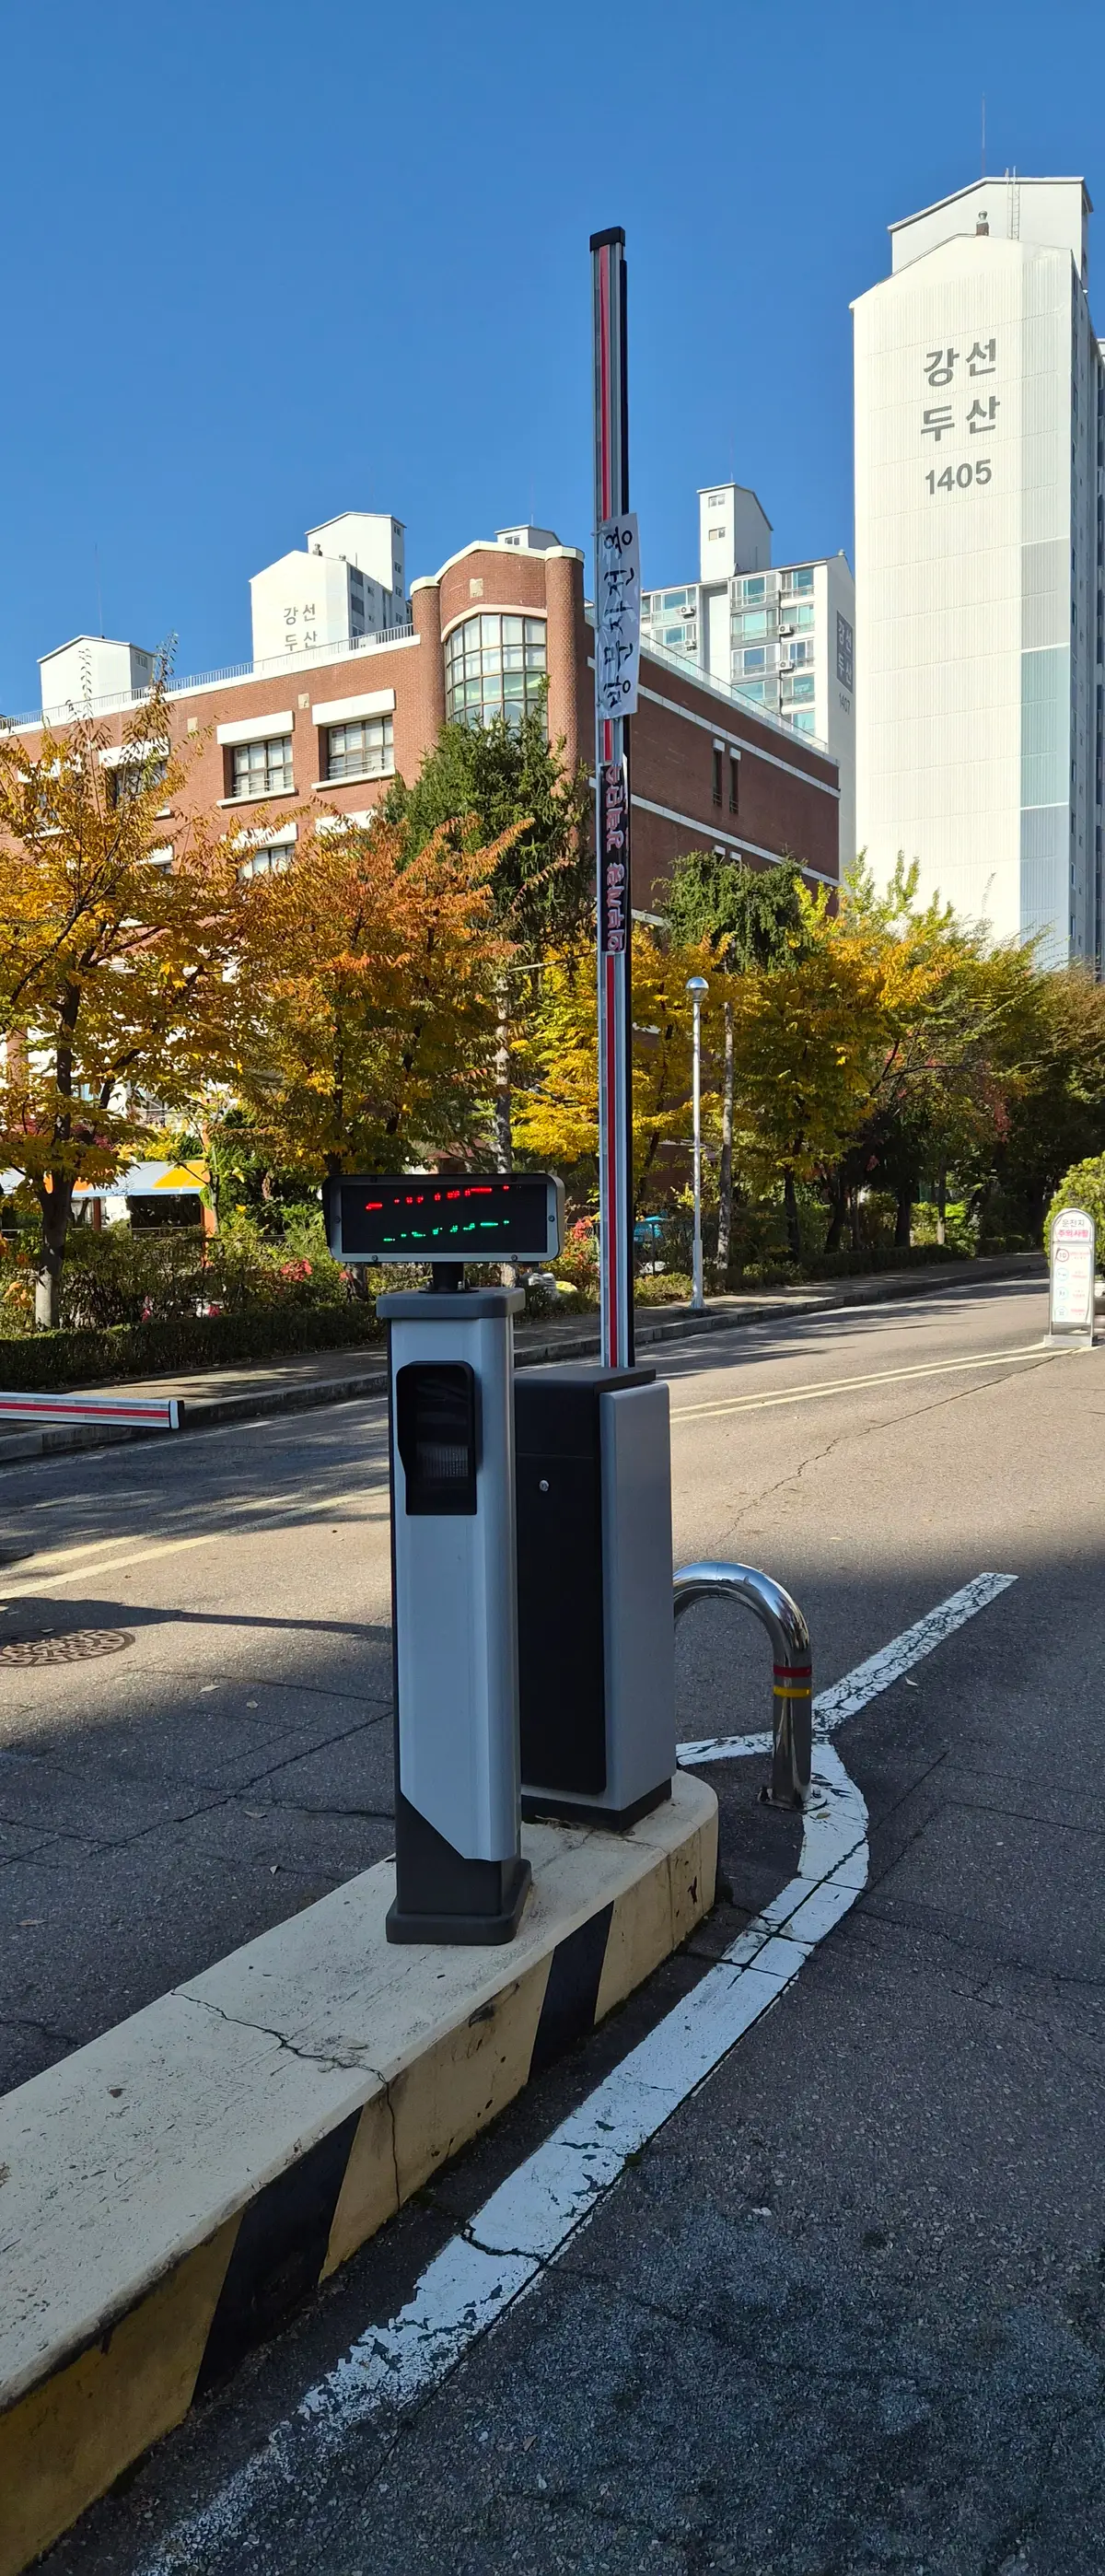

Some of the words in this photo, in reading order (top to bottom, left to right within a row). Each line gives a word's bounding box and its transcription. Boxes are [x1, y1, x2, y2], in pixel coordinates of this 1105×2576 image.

[923, 338, 996, 388] 강선
[920, 395, 1001, 442] 두산
[925, 458, 993, 495] 1405
[283, 602, 316, 625] 강선
[285, 630, 318, 651] 두산
[838, 619, 852, 654] 강선
